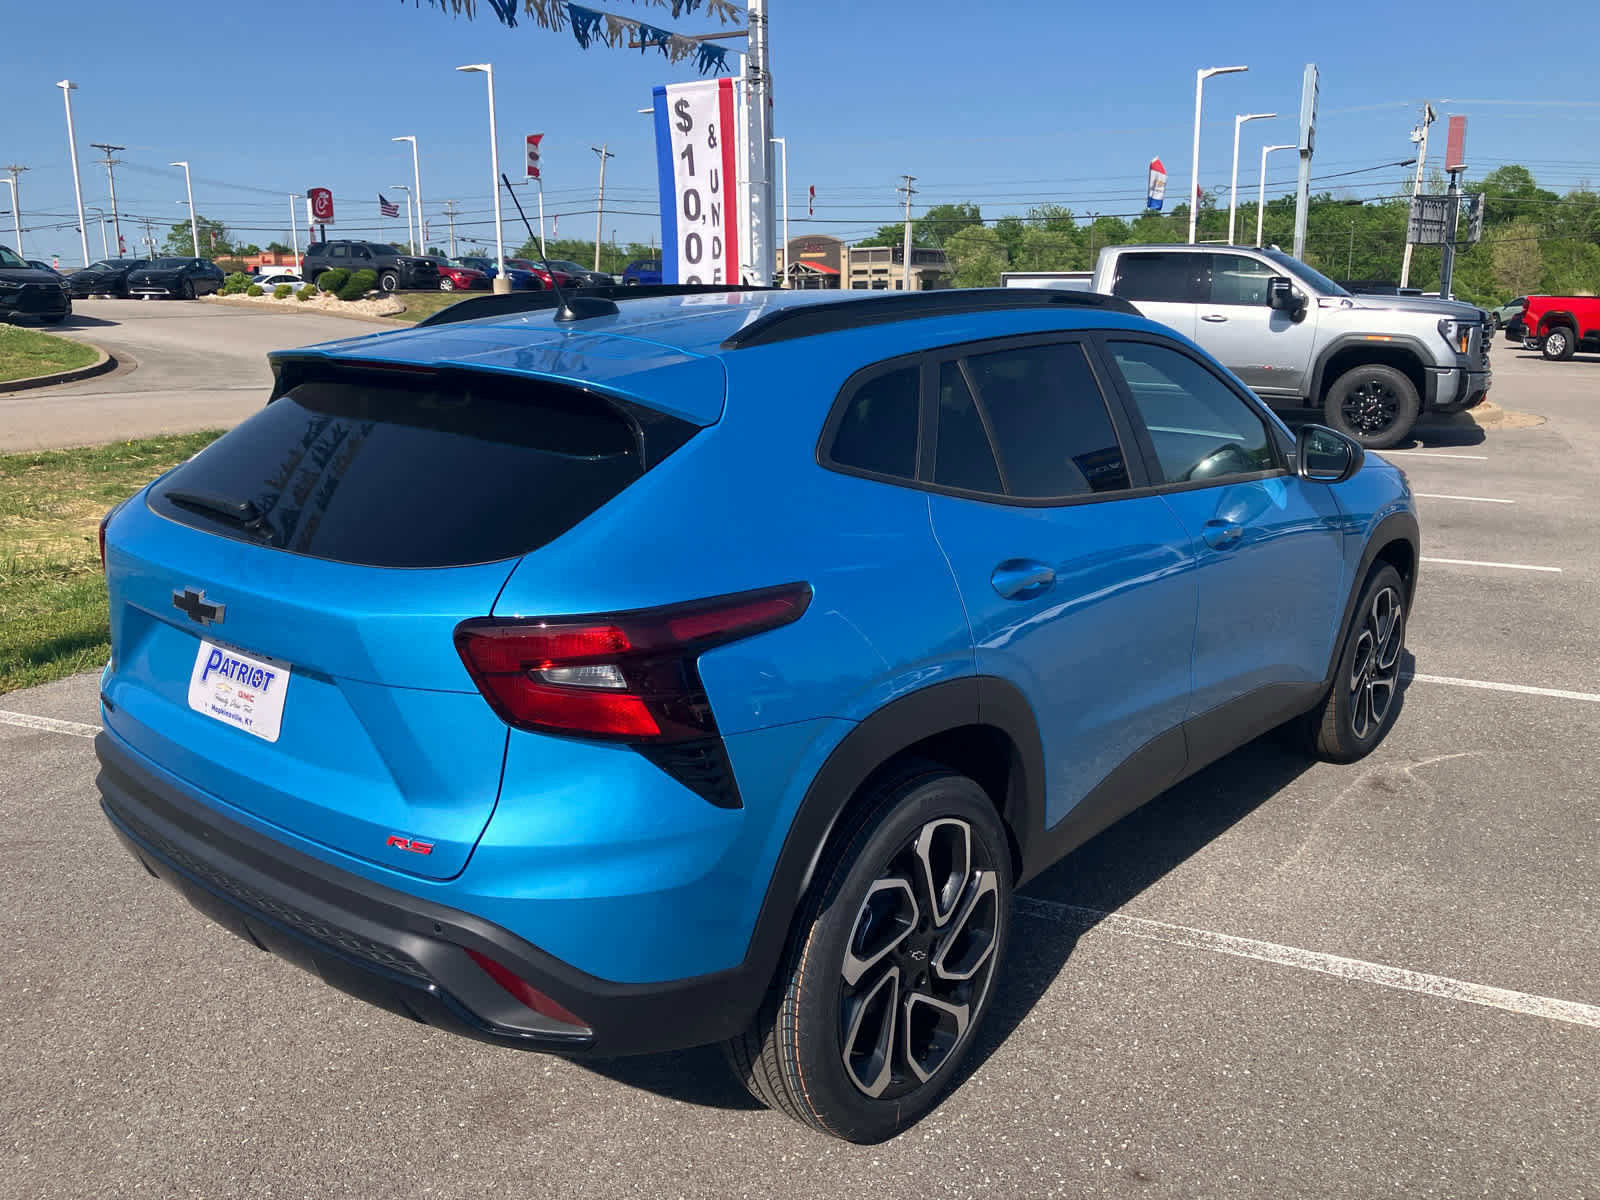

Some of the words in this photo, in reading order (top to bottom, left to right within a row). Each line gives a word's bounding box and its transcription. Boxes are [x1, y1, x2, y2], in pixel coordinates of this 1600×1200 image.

[708, 123, 717, 149] &
[674, 98, 706, 284] $10,00
[202, 649, 275, 691] PATRIOT
[245, 718, 253, 726] KY
[387, 836, 434, 855] RS
